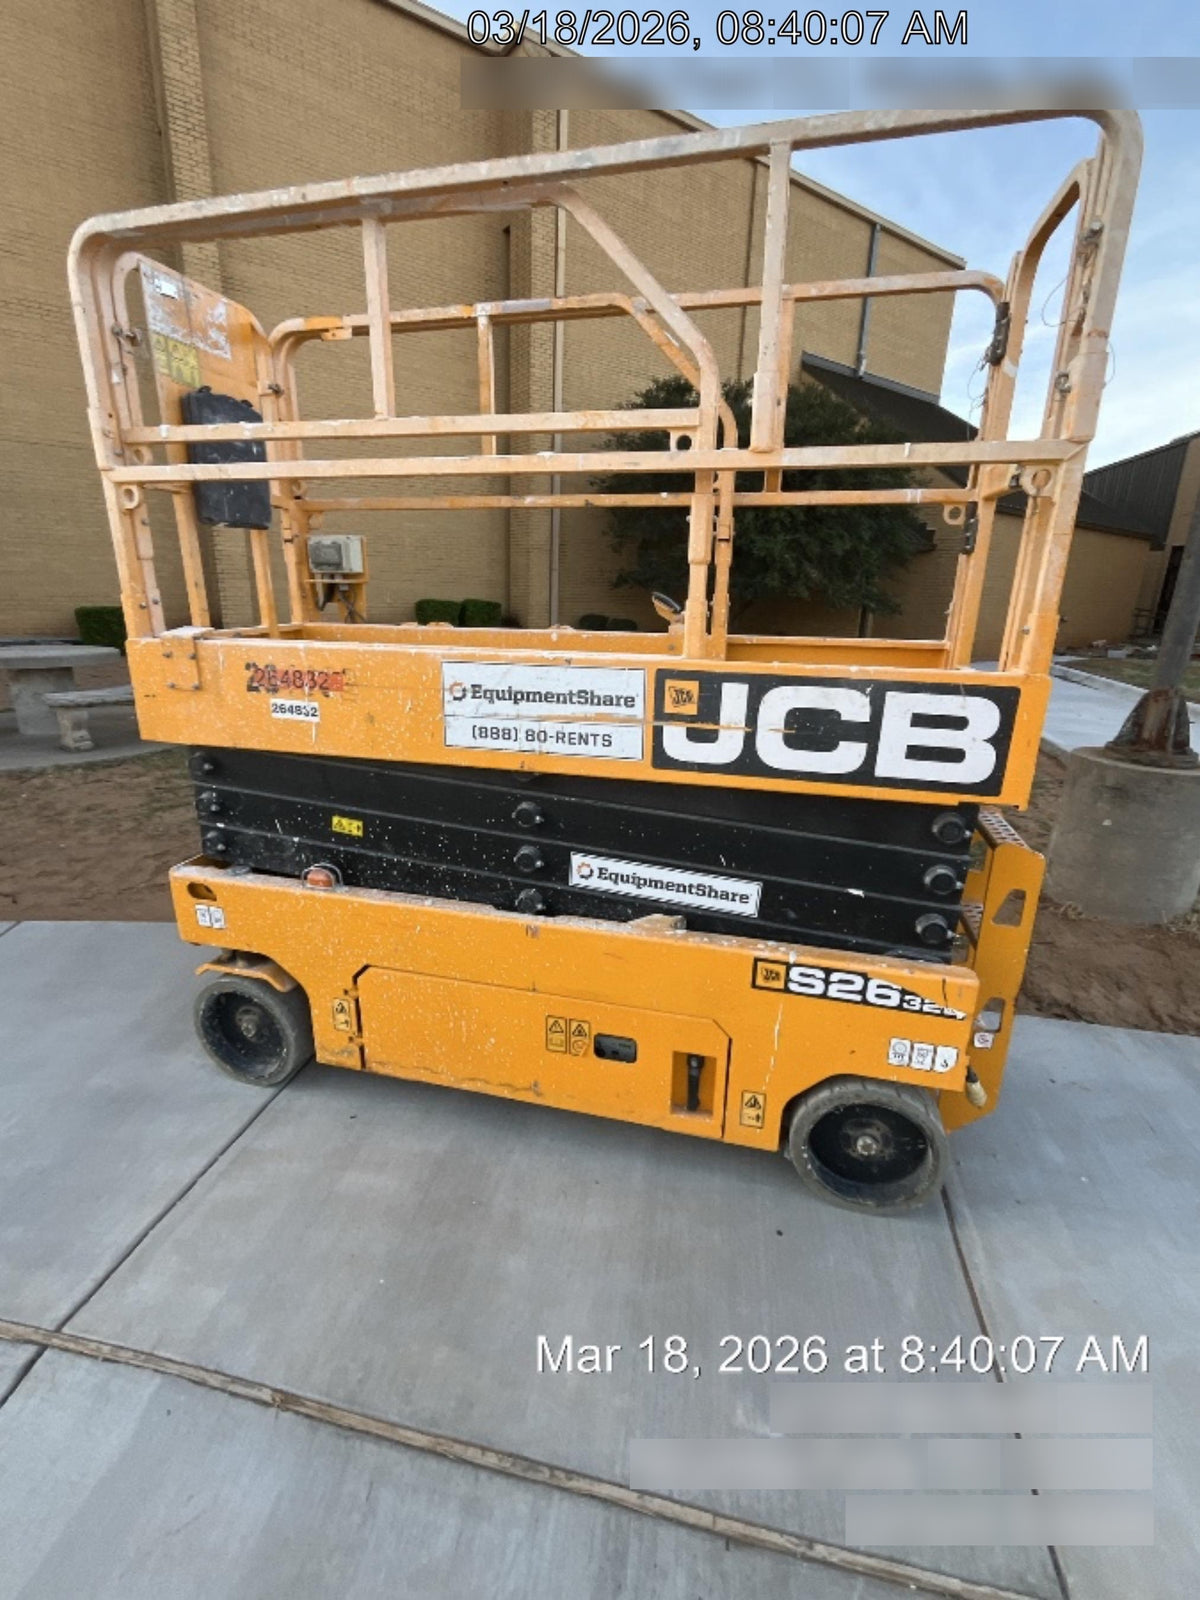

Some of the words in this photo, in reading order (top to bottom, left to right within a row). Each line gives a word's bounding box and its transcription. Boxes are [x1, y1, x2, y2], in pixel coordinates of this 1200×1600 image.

[470, 684, 636, 708] EquipmentShare
[472, 725, 518, 742] (888)
[525, 728, 613, 748] 80-RENTS
[662, 682, 1001, 784] JCB
[596, 866, 750, 904] EquipmentShare
